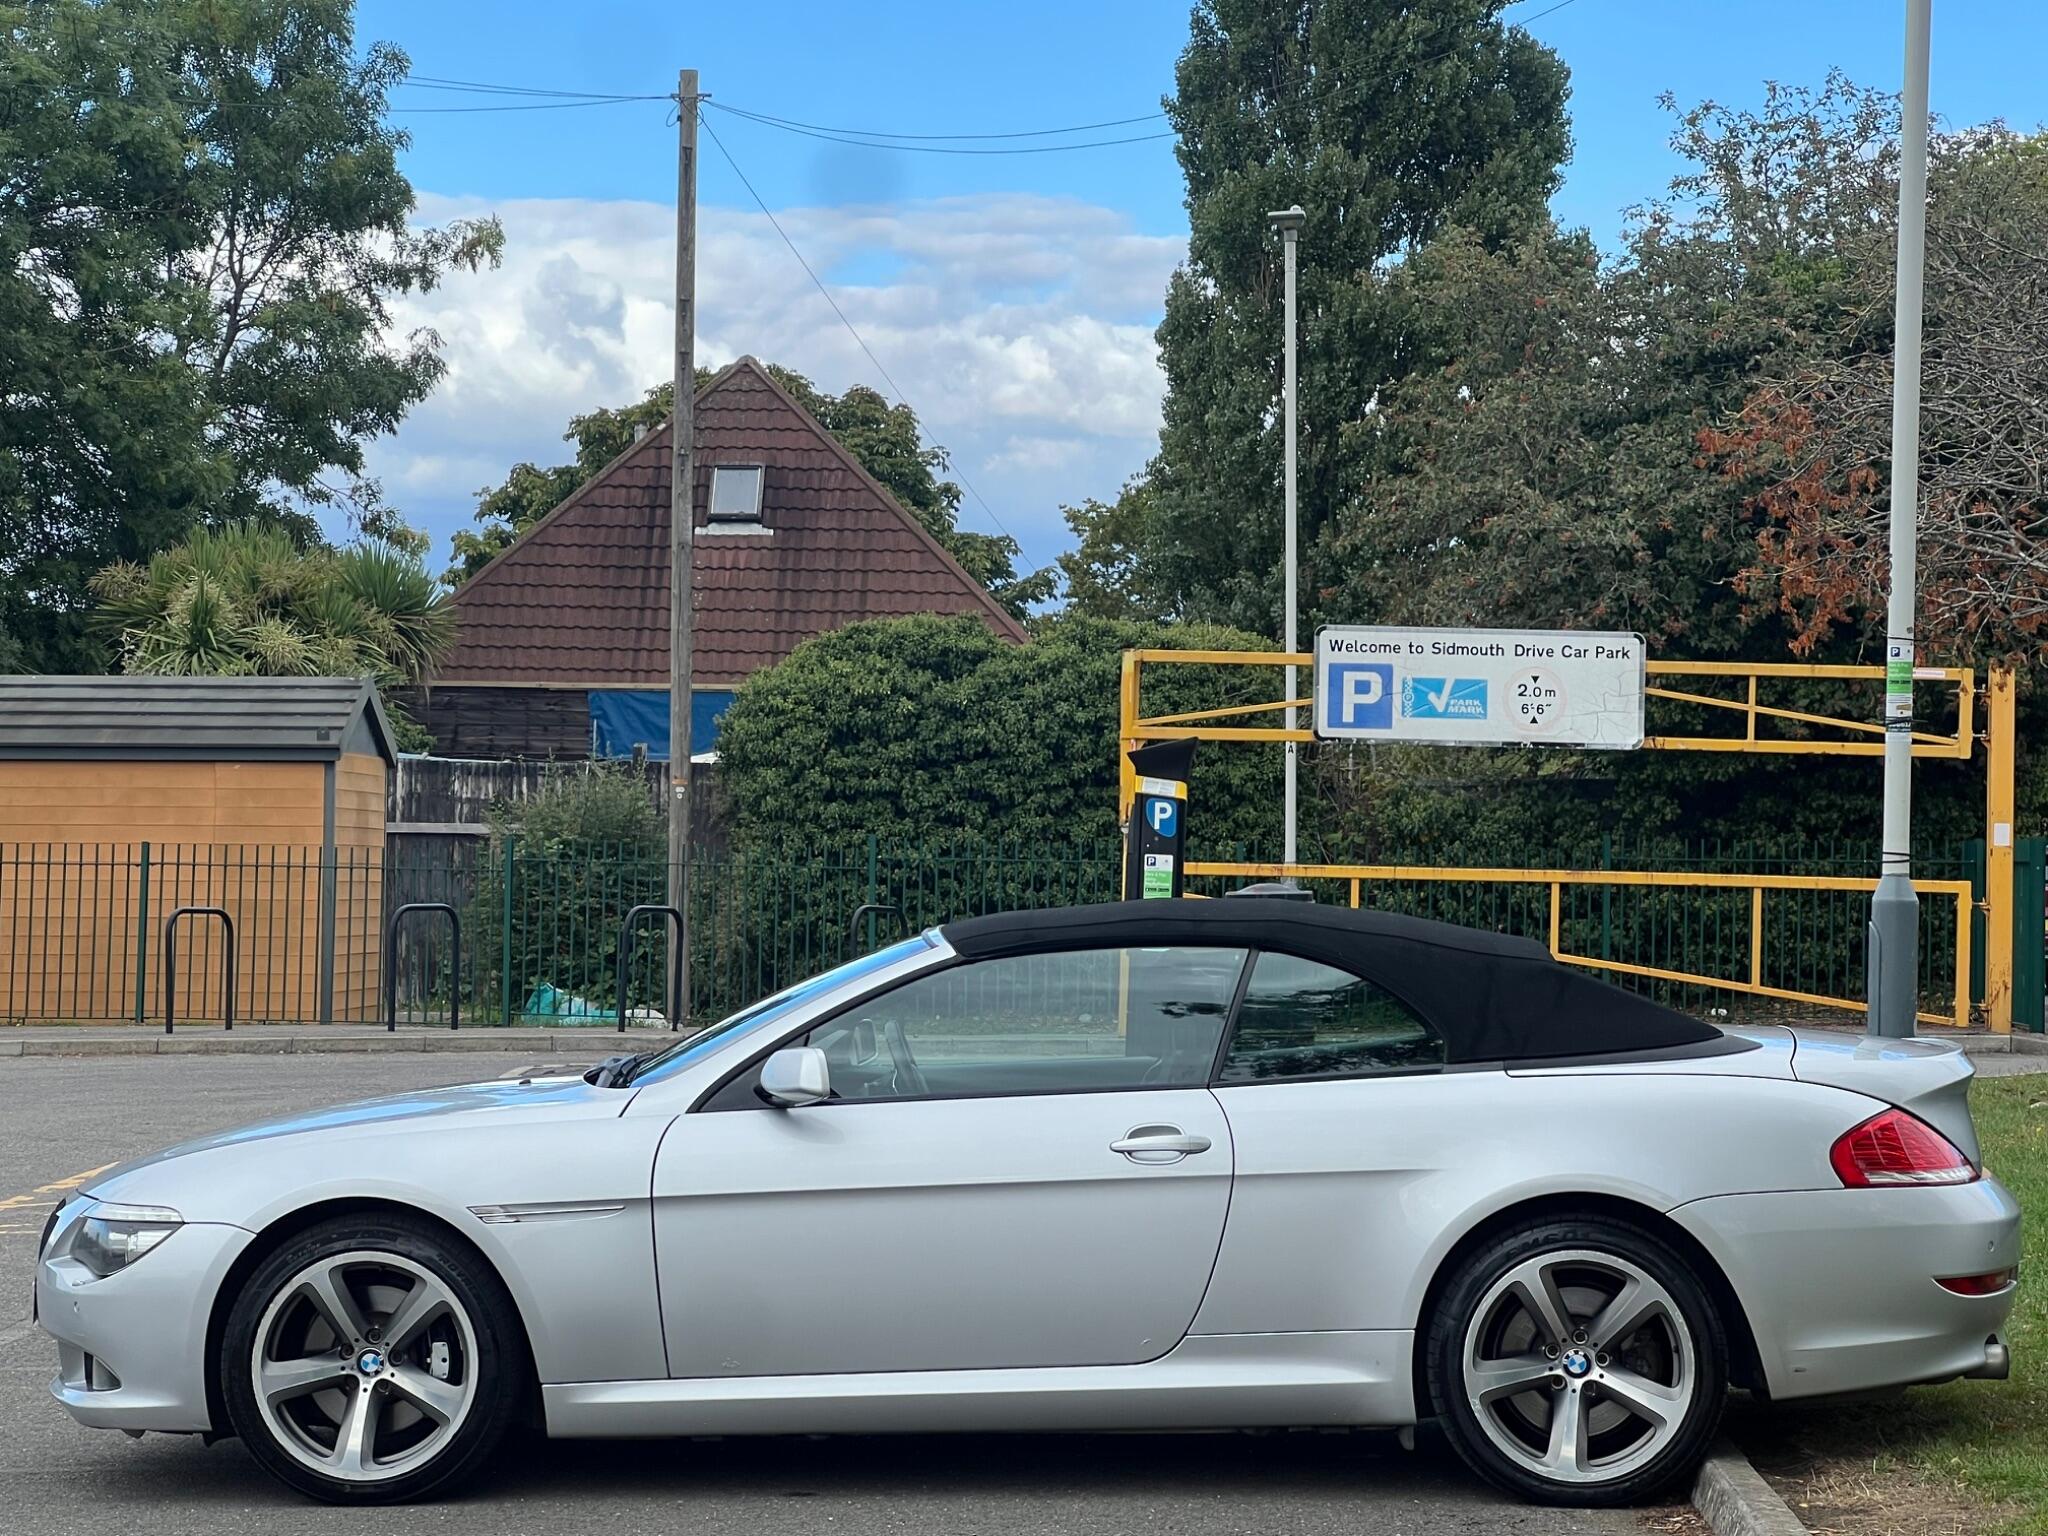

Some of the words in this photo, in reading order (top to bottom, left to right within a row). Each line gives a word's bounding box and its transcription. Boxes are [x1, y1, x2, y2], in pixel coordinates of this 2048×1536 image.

[1329, 639, 1401, 654] Welcome
[1408, 642, 1424, 655] to
[1431, 641, 1505, 657] Sidmouth
[1514, 644, 1554, 658] Drive
[1561, 645, 1589, 659] Car
[1595, 646, 1630, 660] Park
[1342, 671, 1383, 723] P
[1447, 705, 1485, 714] MARK
[1153, 802, 1173, 830] P
